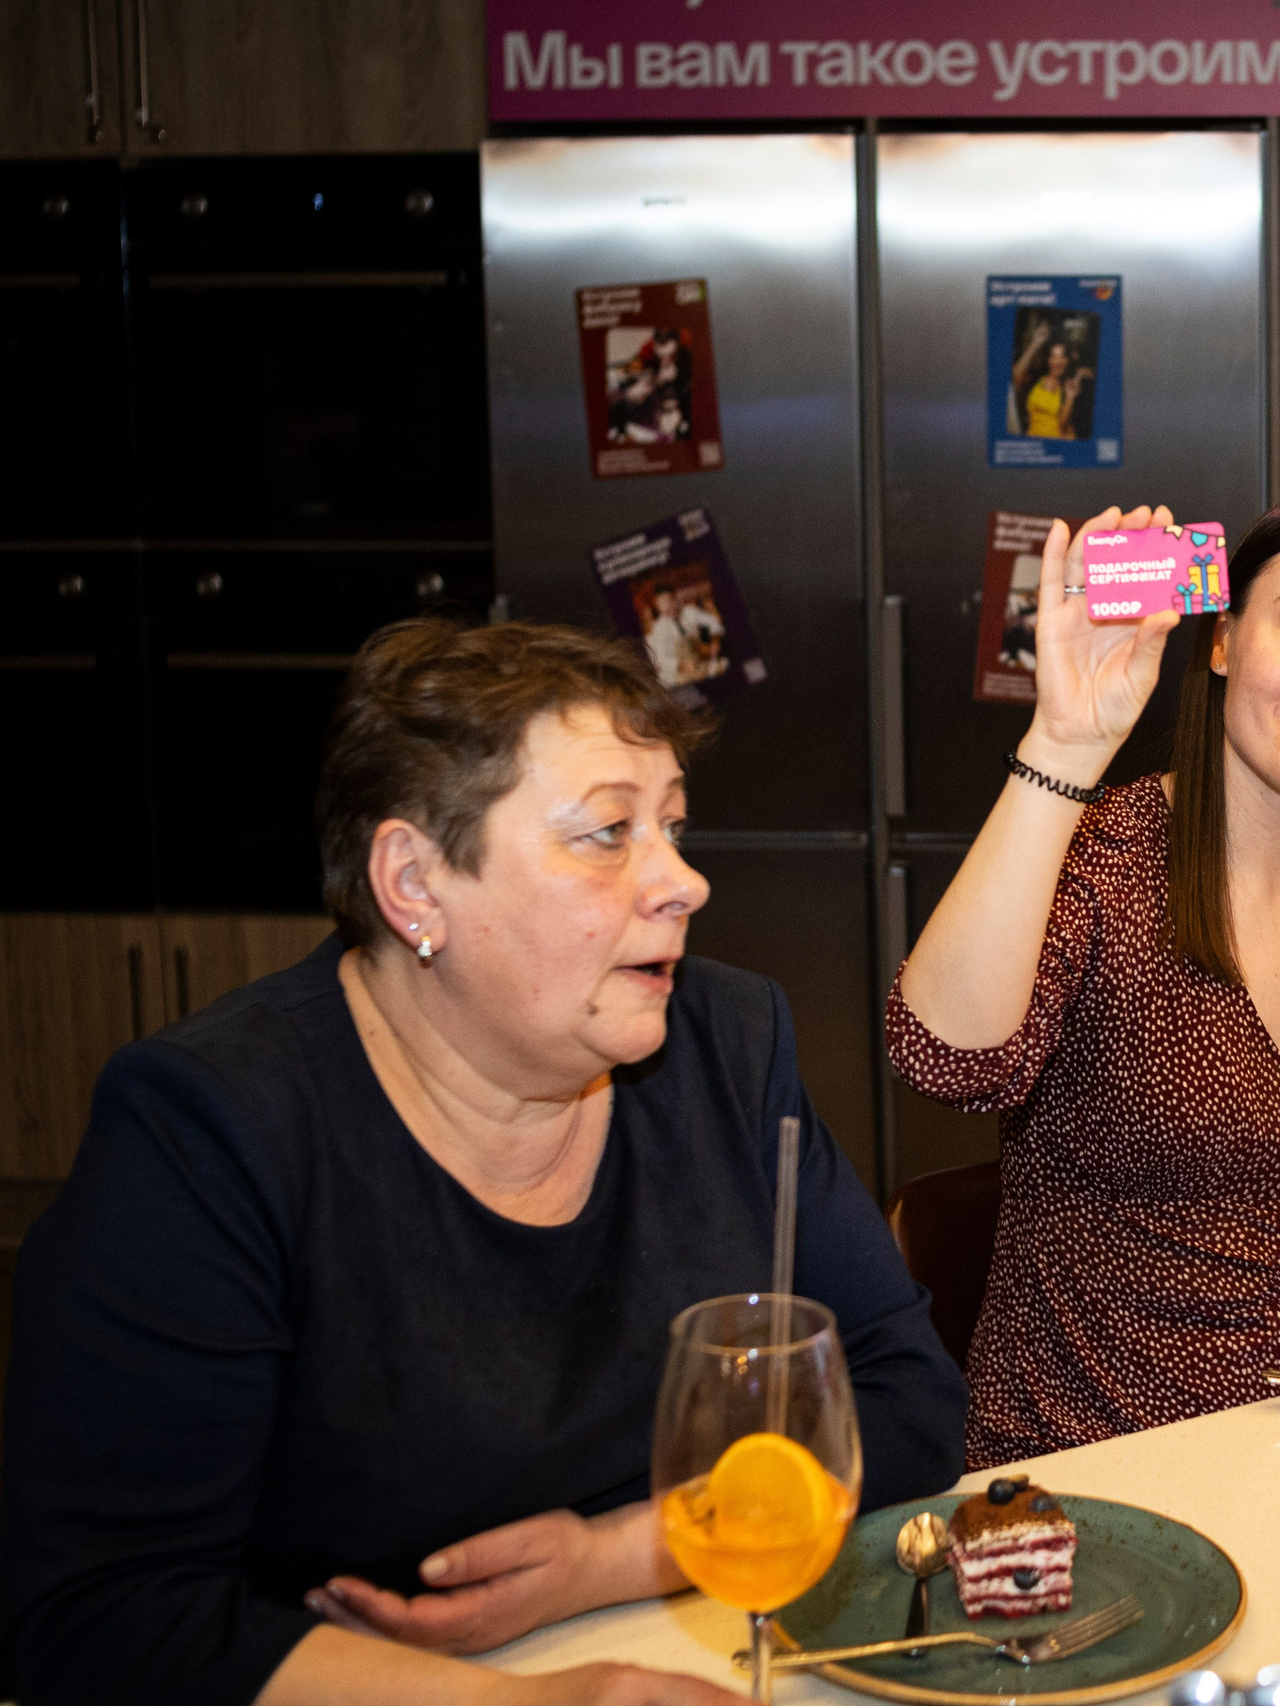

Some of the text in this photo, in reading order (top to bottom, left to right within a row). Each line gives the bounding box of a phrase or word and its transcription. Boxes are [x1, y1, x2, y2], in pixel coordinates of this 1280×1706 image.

[502, 31, 622, 90] Мы
[634, 43, 771, 88] вам
[779, 39, 979, 88] такое
[1088, 557, 1176, 573] ПОДАРОЧНЫЙ
[1088, 570, 1172, 584] СЕРТИФИКАТ
